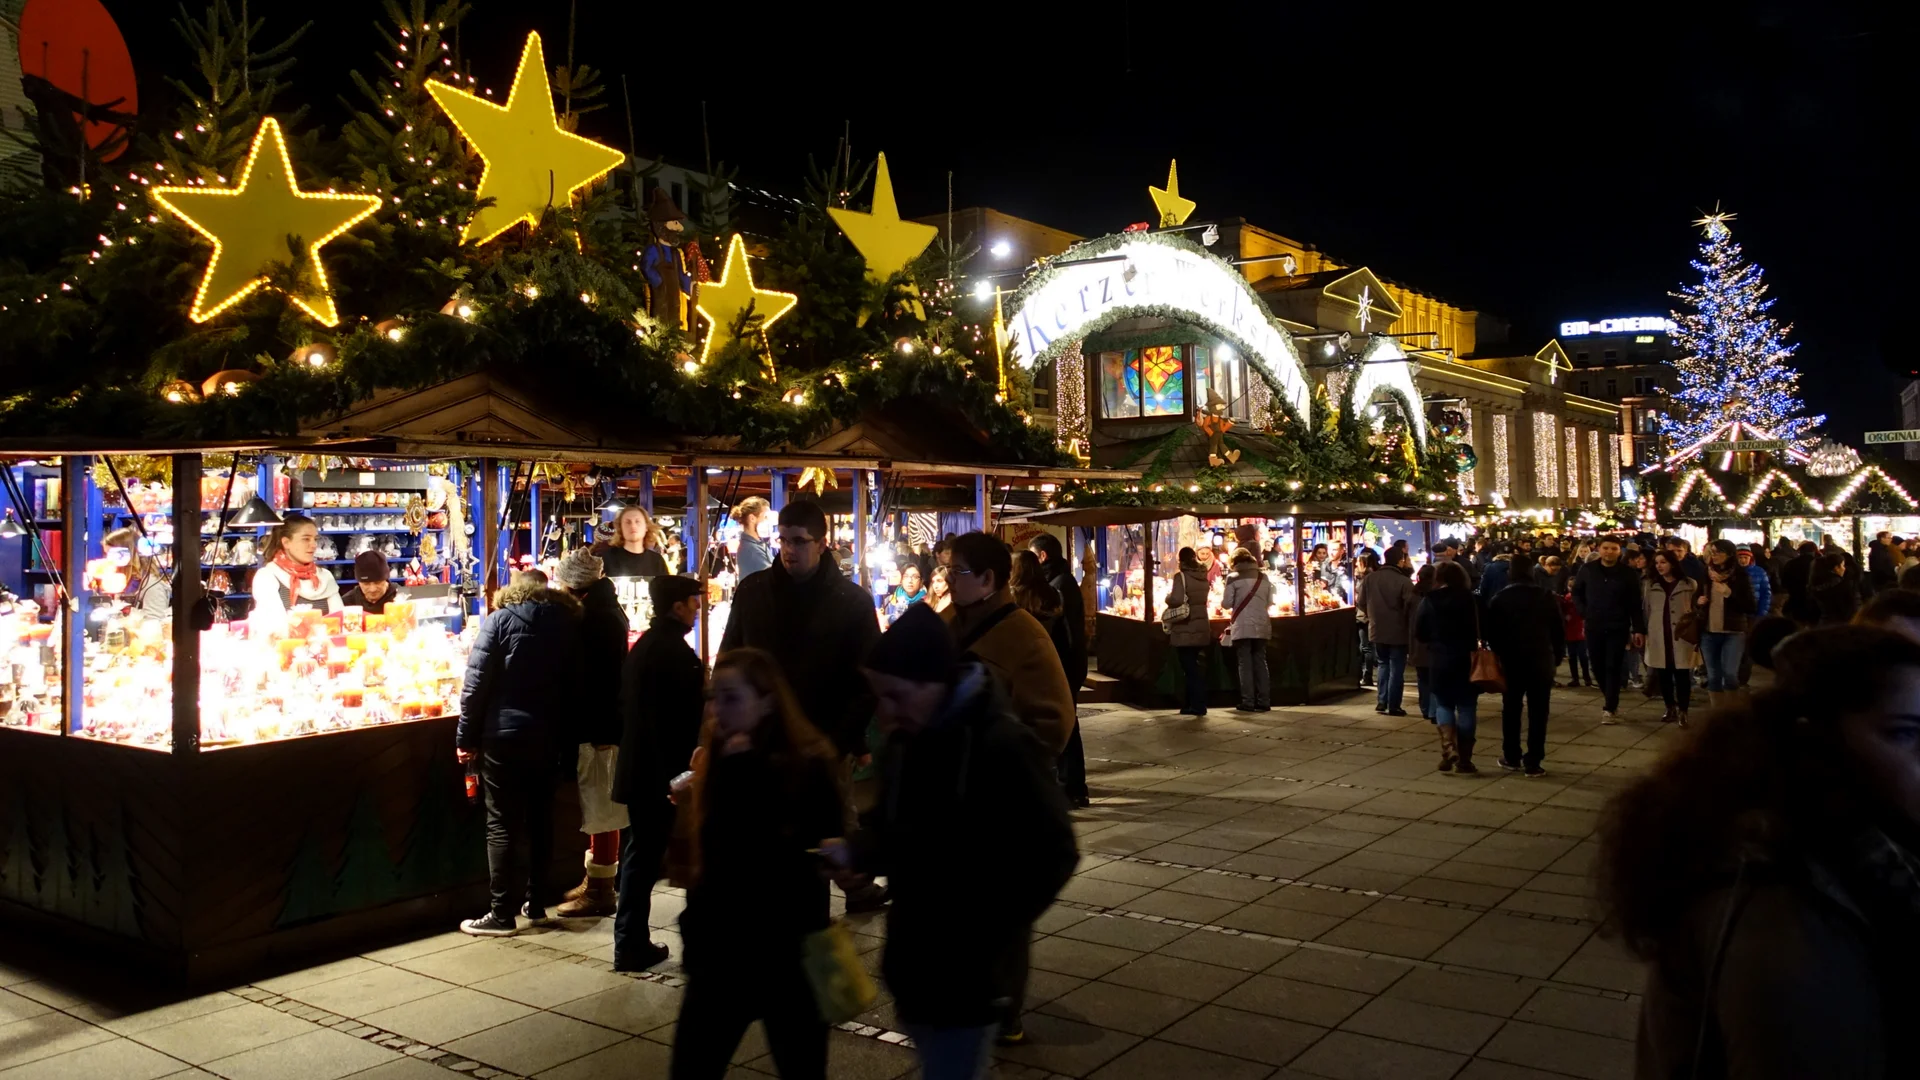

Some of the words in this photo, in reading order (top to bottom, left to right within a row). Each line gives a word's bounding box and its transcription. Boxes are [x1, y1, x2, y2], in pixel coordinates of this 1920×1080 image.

[1868, 431, 1920, 443] ORIGINAL
[1703, 442, 1736, 451] ORIGINAL
[1737, 440, 1786, 450] ERZGEBIRGE
